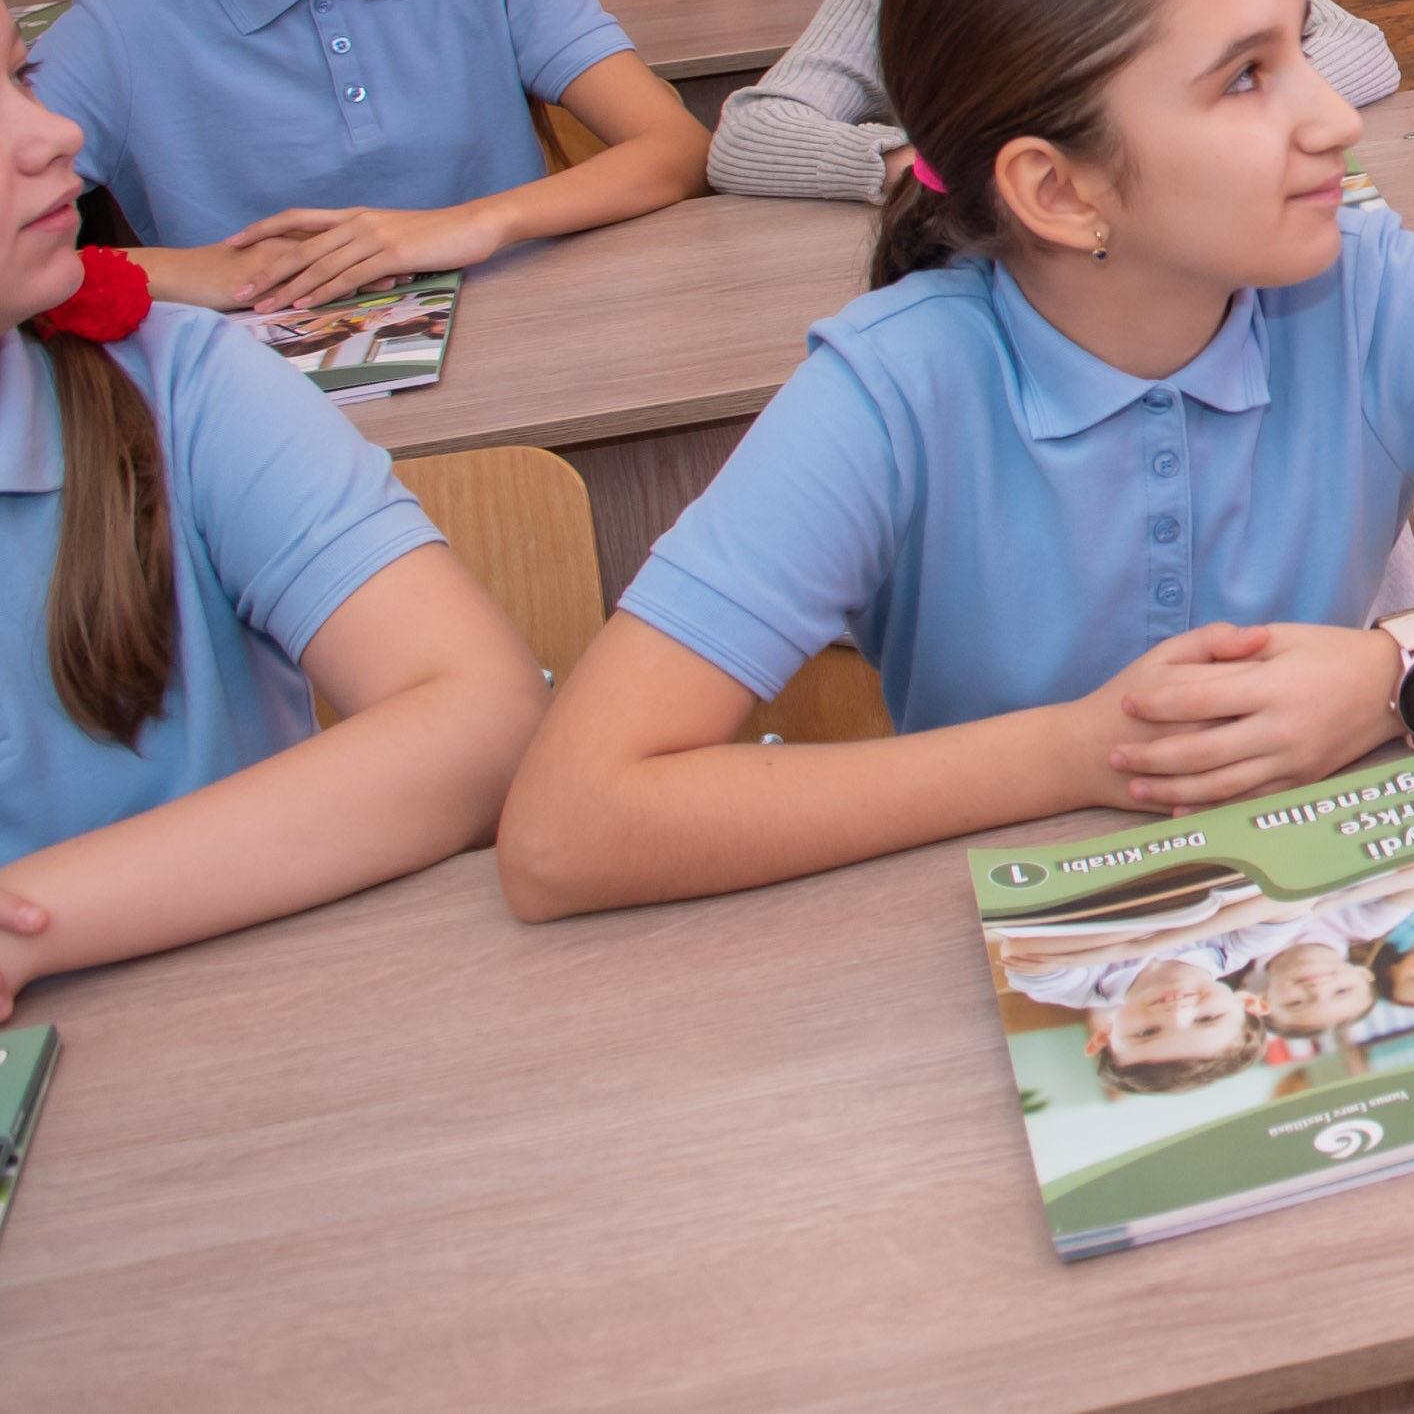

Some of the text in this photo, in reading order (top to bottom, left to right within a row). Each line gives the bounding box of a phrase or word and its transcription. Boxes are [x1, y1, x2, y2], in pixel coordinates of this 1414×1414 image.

[1148, 831, 1207, 855] Ders
[1010, 864, 1030, 884] 1
[1369, 1090, 1409, 1107] Yunus
[1333, 1101, 1367, 1118] Emre
